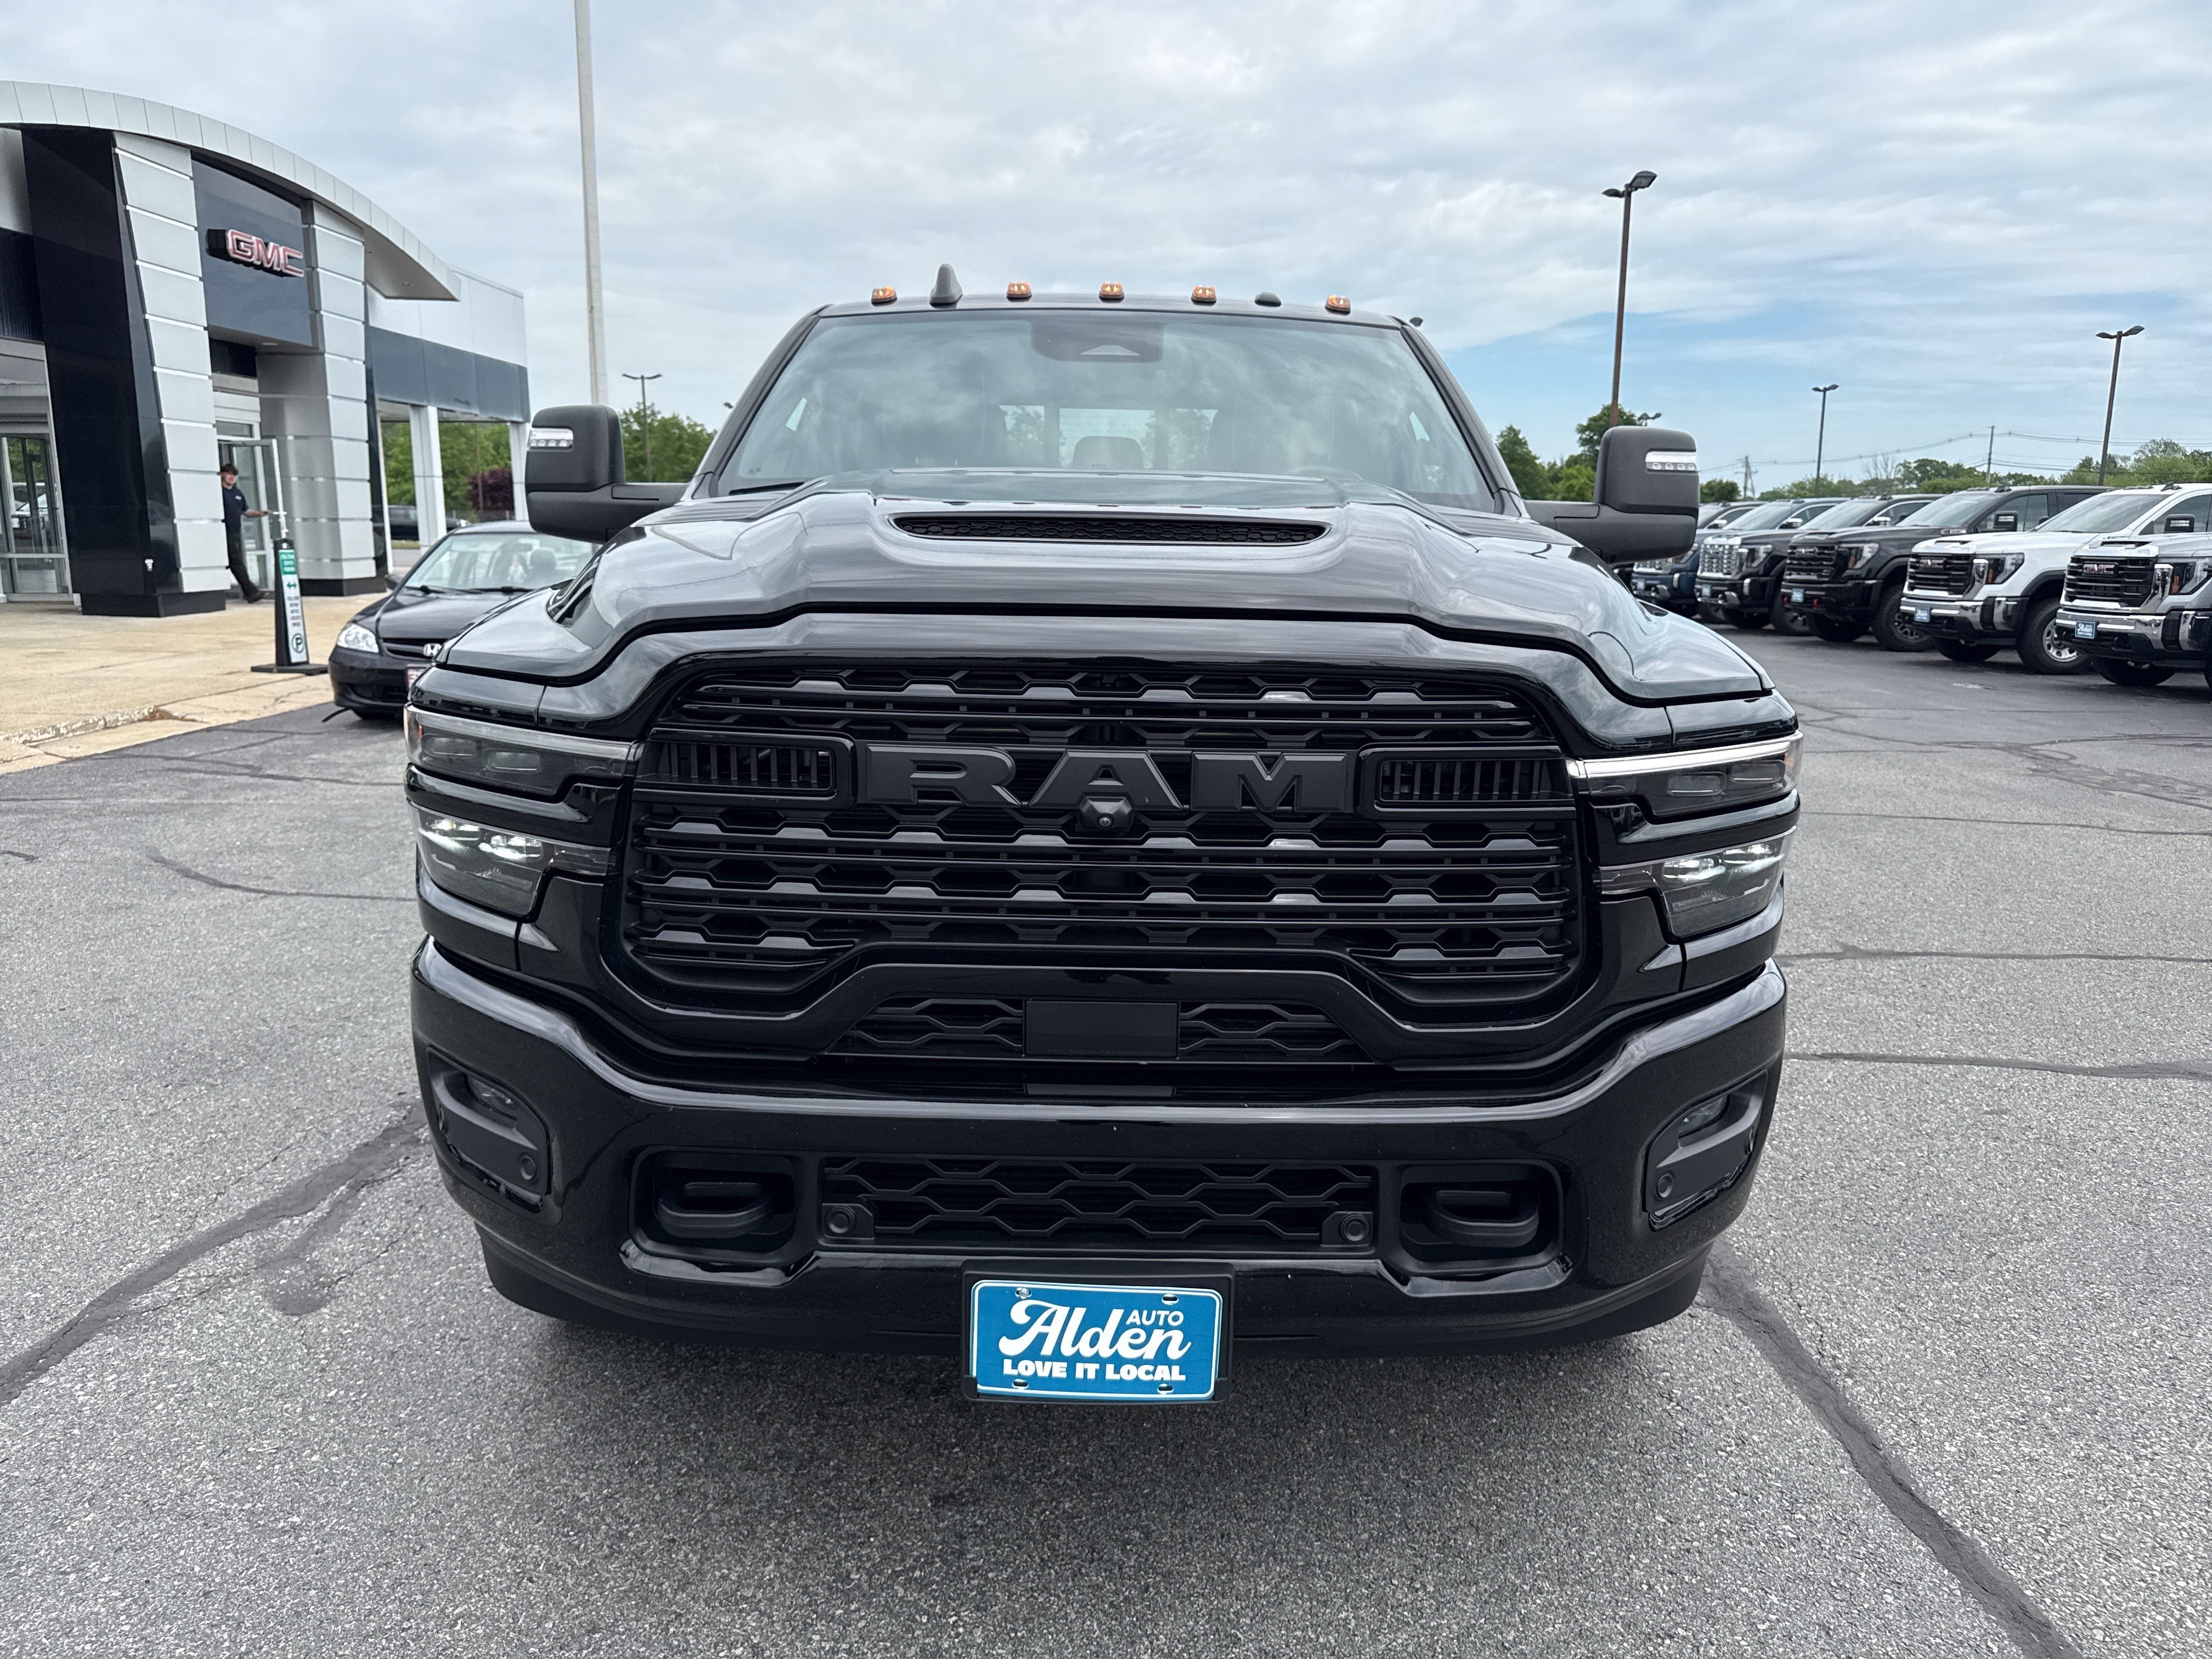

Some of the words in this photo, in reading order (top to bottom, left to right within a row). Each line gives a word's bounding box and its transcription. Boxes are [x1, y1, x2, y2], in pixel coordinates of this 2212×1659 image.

[227, 229, 304, 277] GMC
[2083, 564, 2115, 574] GMC
[866, 742, 1347, 812] RAM
[998, 1299, 1192, 1360] Alden
[1125, 1309, 1184, 1327] AUTO
[1003, 1359, 1067, 1378] LOVE
[1075, 1362, 1099, 1380] IT
[1105, 1363, 1186, 1381] LOCAL
